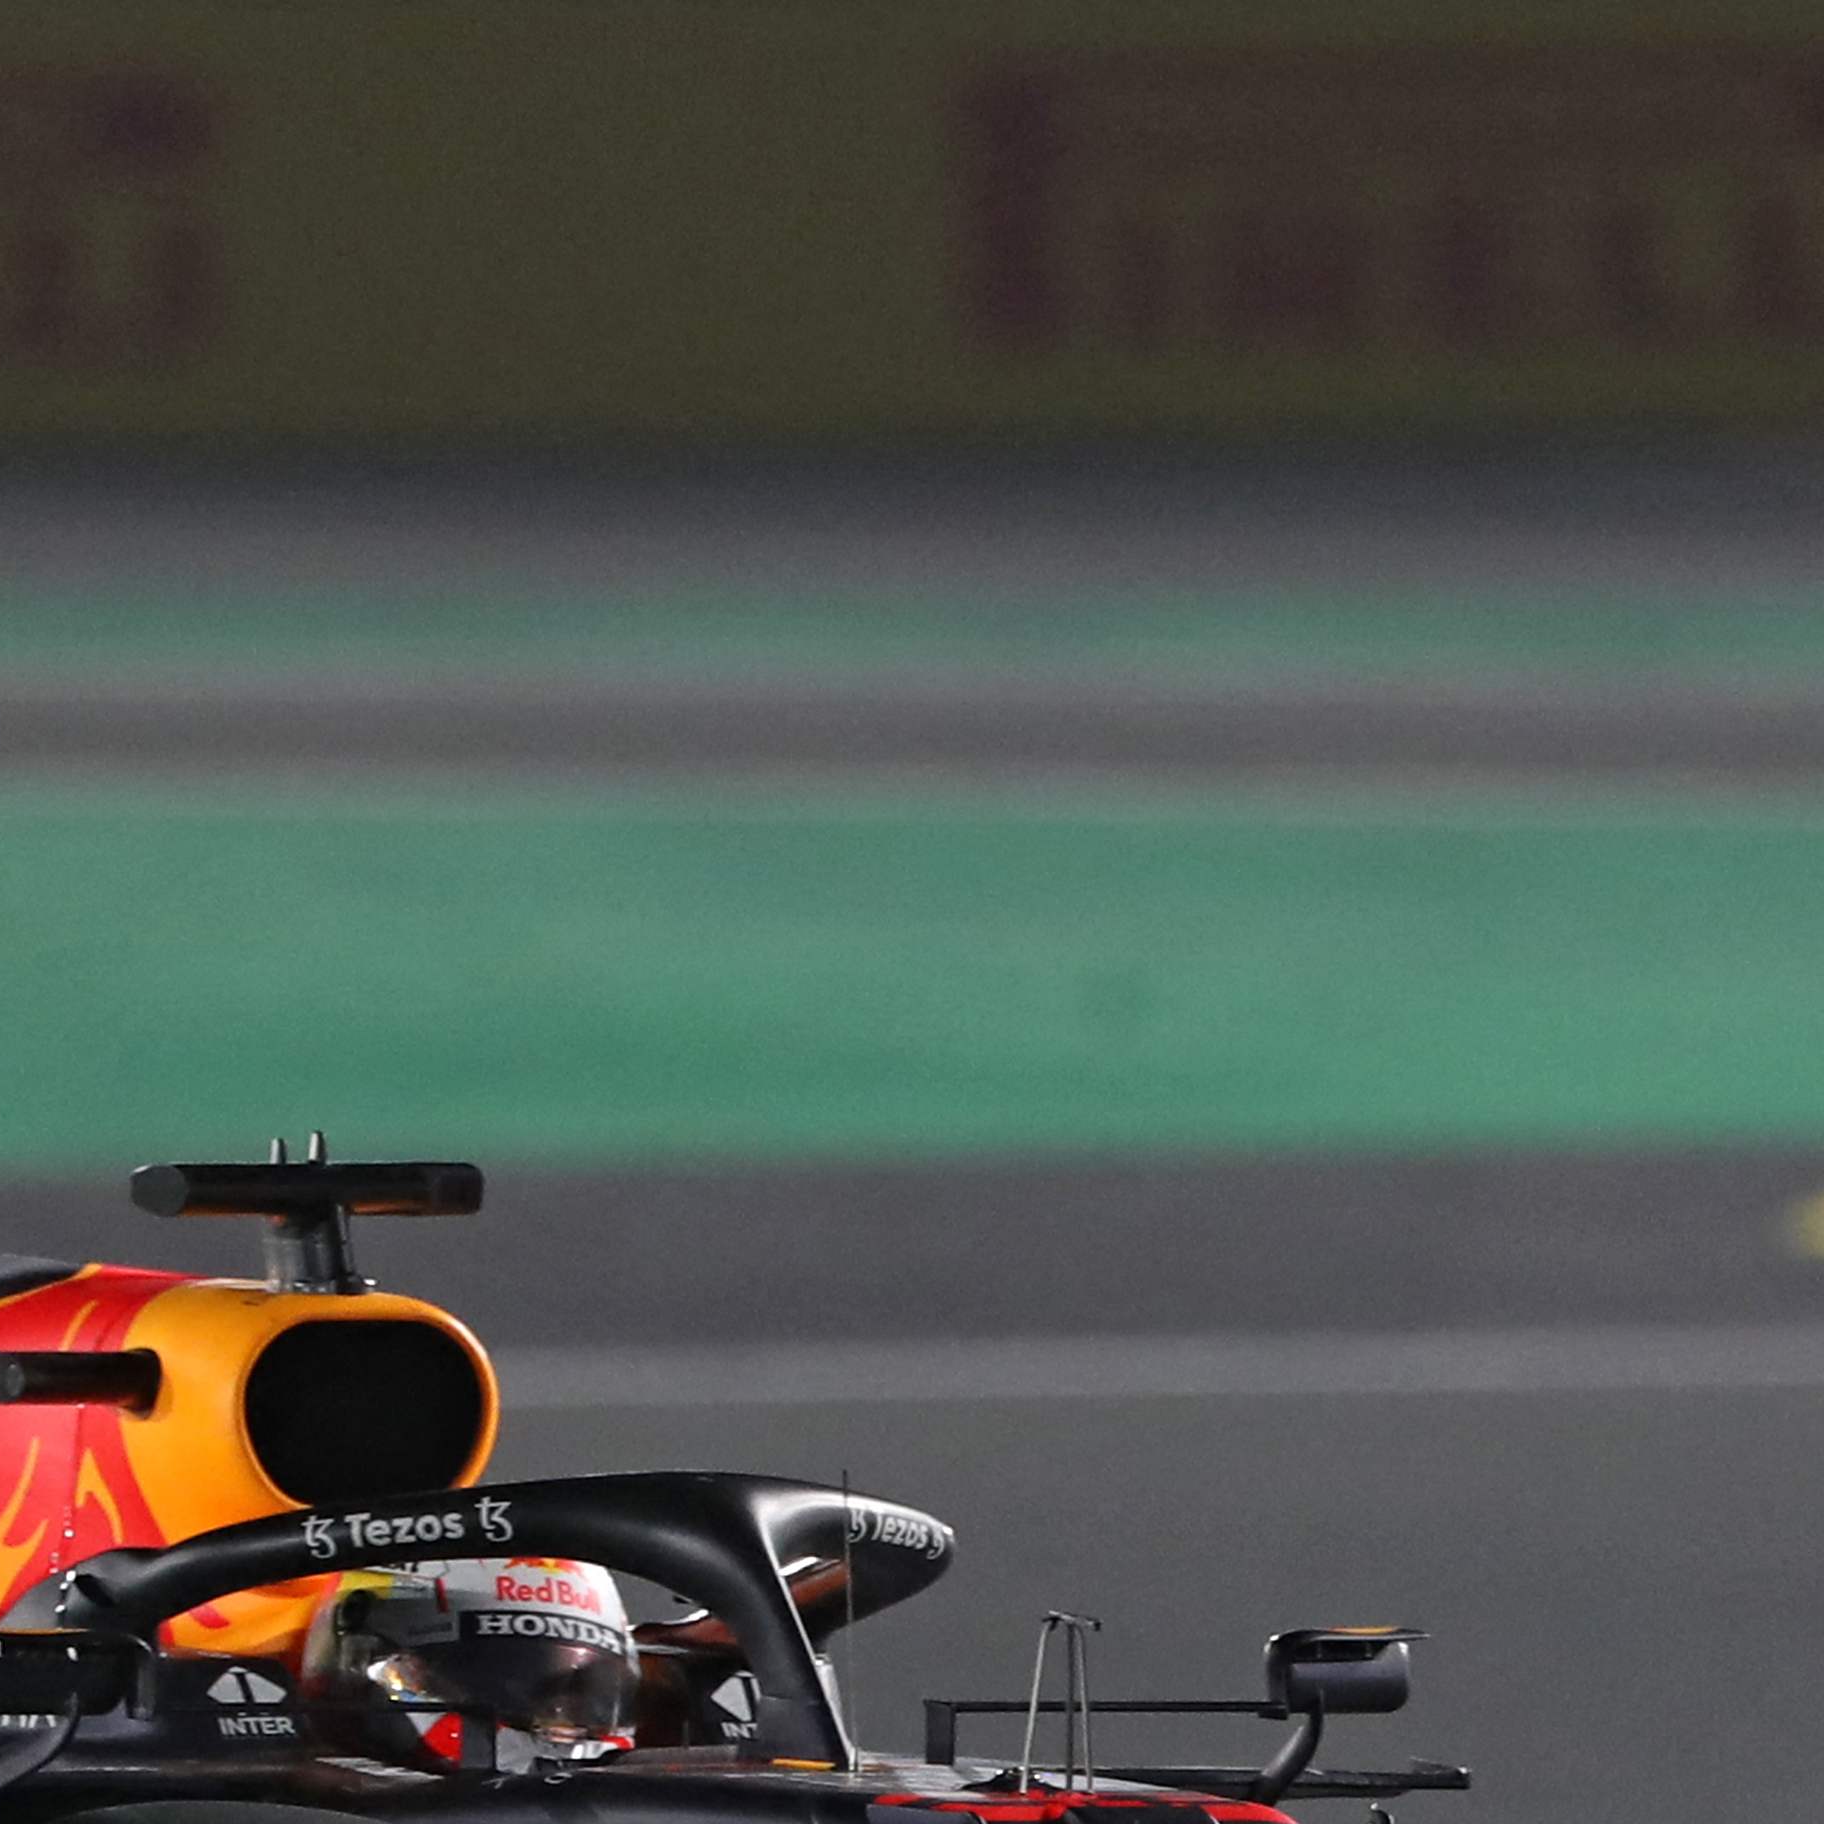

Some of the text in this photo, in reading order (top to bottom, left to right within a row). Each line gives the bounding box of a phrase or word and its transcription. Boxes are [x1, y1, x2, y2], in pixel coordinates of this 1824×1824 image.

[344, 1511, 465, 1548] Tezos
[495, 1575, 601, 1613] Red Bull
[478, 1615, 622, 1655] HONDA
[218, 1713, 295, 1737] INTER
